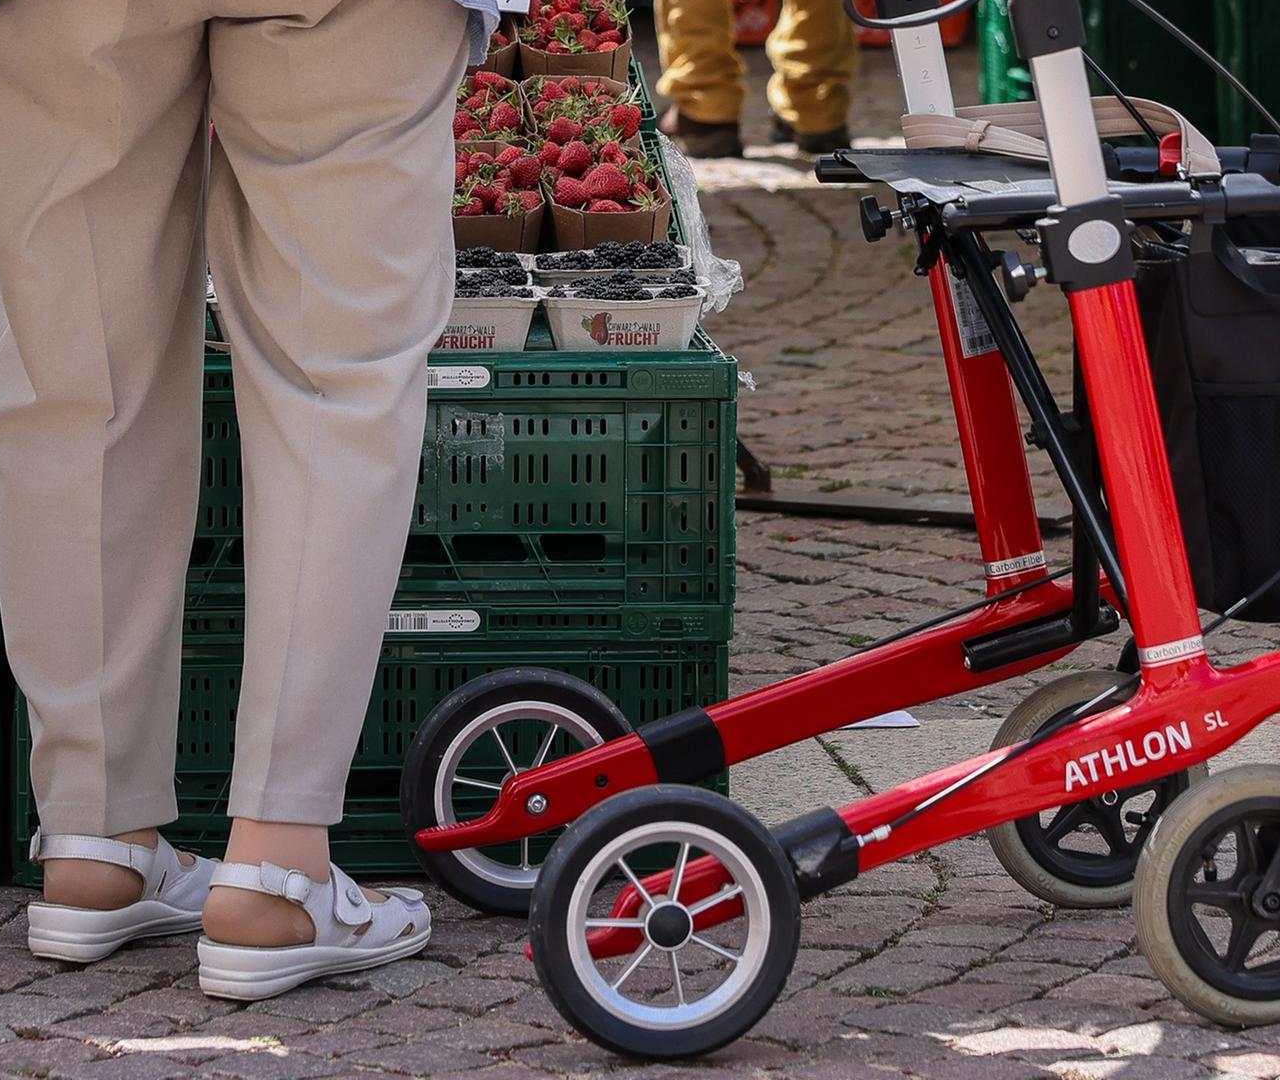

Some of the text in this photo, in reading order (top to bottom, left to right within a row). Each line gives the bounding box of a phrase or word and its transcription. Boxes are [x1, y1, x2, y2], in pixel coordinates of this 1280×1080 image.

[921, 69, 931, 80] 2
[928, 103, 937, 113] 3
[442, 335, 496, 350] FRUCHT
[607, 332, 661, 346] FRUCHT
[990, 553, 1043, 574] Carbon Fiber
[1146, 638, 1202, 661] Carbon Fibe
[1065, 710, 1229, 792] ATHLON SL
